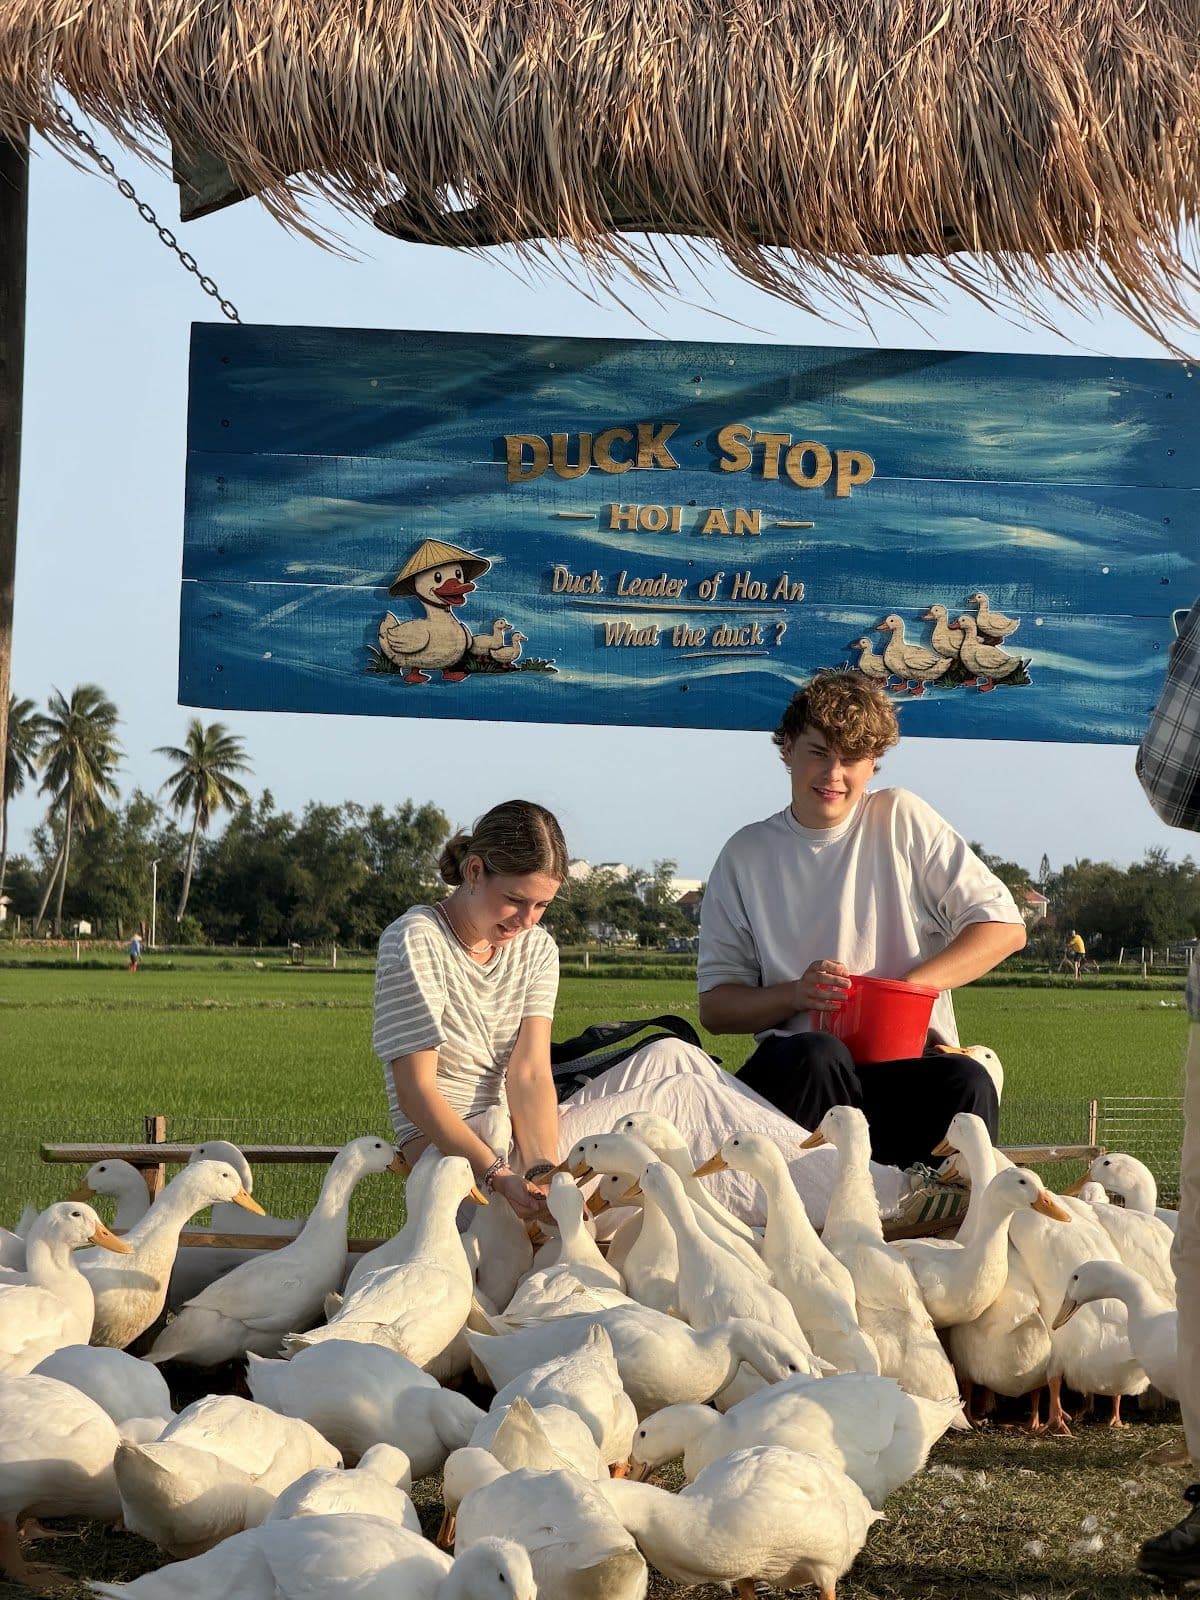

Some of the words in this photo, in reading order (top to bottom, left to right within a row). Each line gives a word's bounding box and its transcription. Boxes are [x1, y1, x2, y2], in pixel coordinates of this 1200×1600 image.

[505, 423, 680, 482] DUCK
[716, 423, 876, 497] STOP
[609, 503, 682, 533] HOI
[702, 507, 763, 536] AN
[552, 566, 605, 594] Duck
[617, 570, 688, 598] Leader
[698, 571, 725, 601] of
[603, 621, 660, 647] What
[672, 623, 706, 647] the
[711, 621, 765, 647] duck
[775, 620, 787, 645] ?
